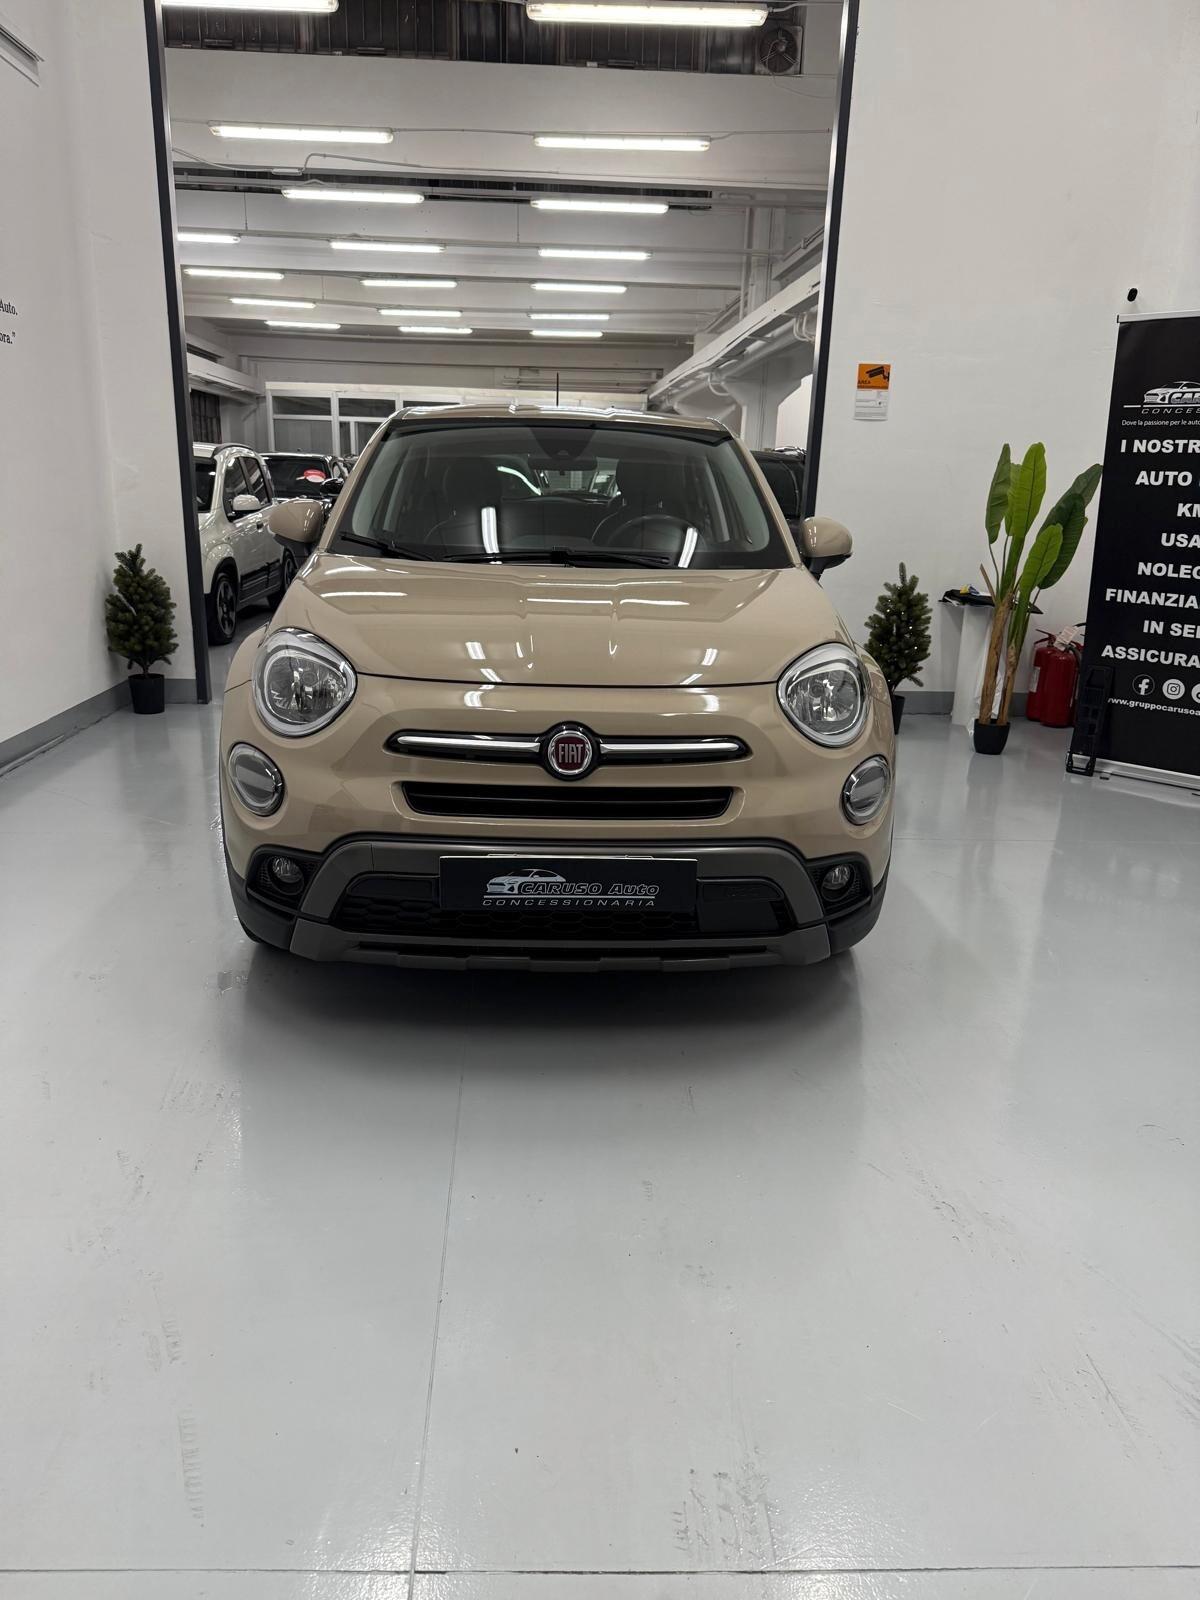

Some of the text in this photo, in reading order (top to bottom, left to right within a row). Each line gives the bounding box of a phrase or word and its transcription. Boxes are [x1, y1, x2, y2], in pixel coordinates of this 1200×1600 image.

[1120, 439, 1200, 454] I NOSTR
[1135, 470, 1193, 486] AUTO
[1161, 532, 1200, 548] USA
[1143, 620, 1164, 635] IN
[1101, 644, 1200, 669] ASSICURA
[558, 743, 584, 764] FIAT
[520, 882, 660, 896] CARUSO Auto
[482, 899, 655, 907] CONCESSIONARIA
